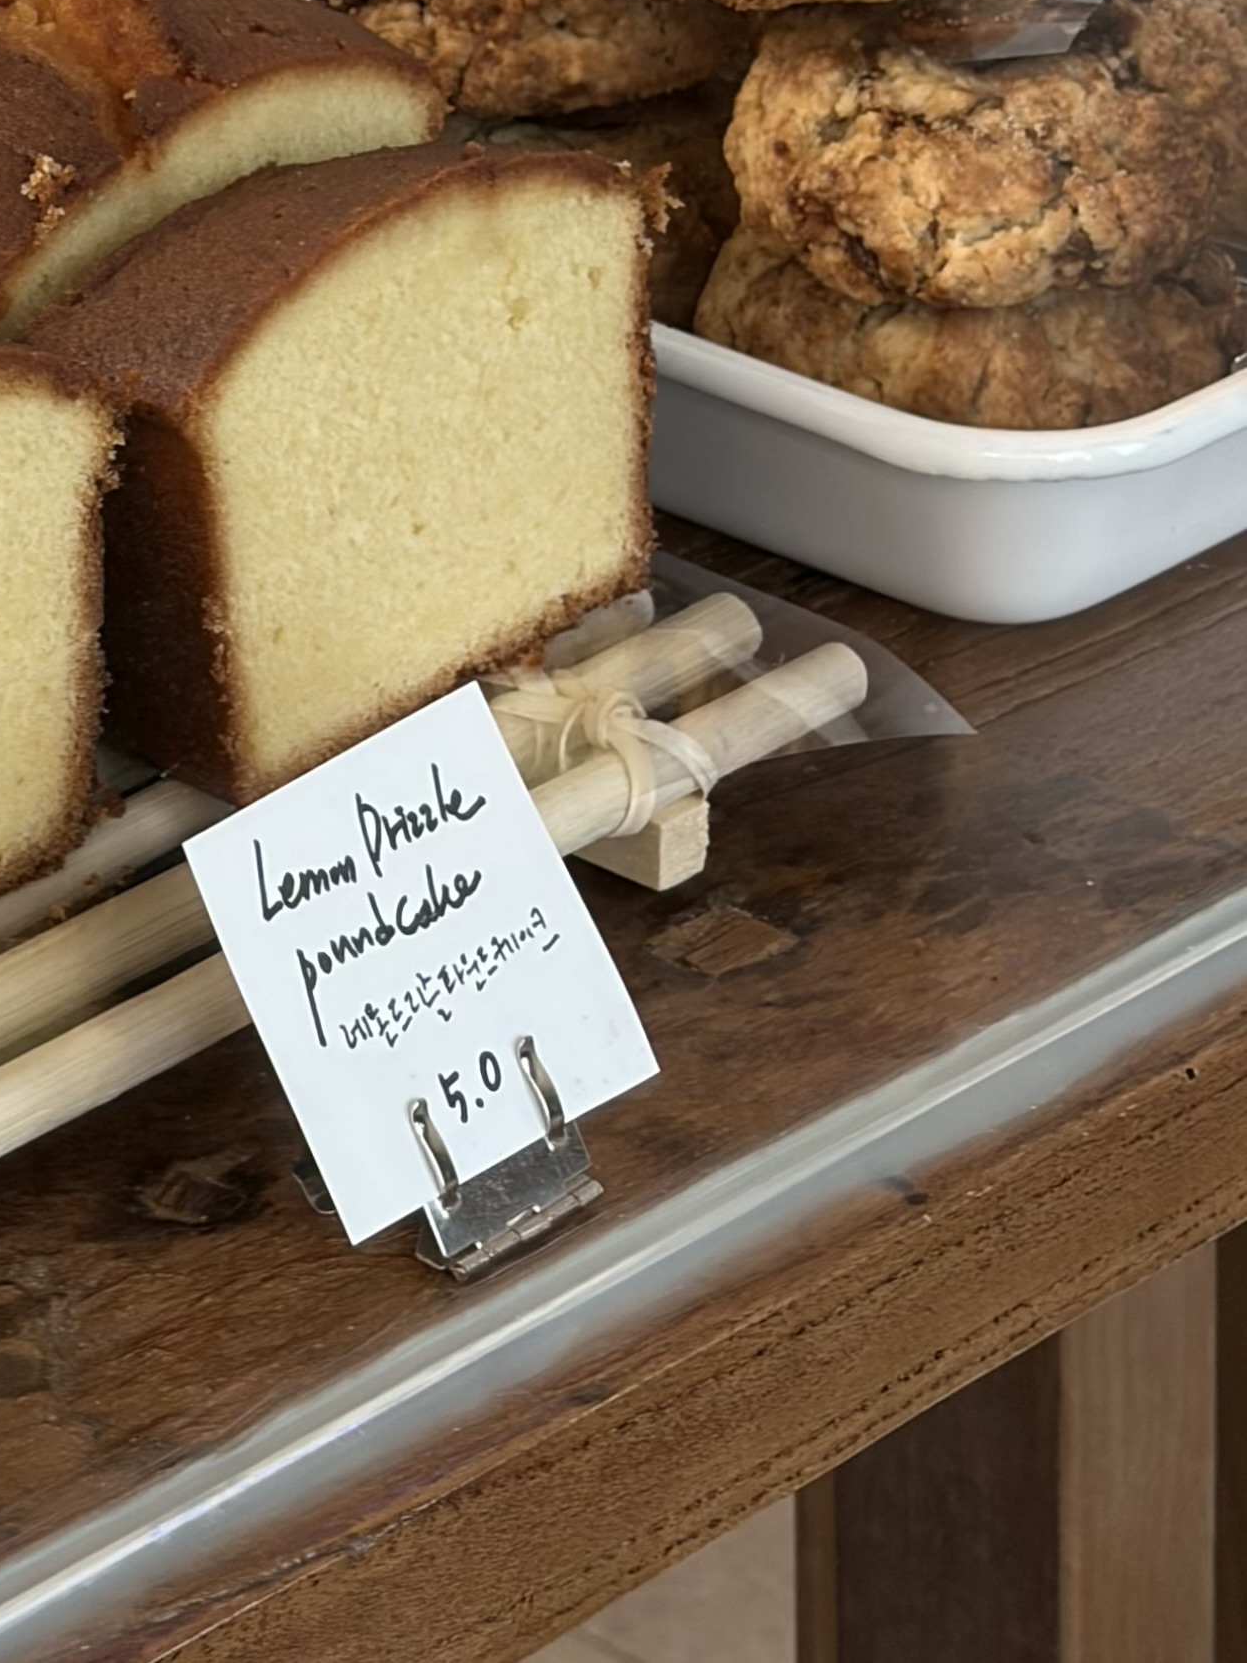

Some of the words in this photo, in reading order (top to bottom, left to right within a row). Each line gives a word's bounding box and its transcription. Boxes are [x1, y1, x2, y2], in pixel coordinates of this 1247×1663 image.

[253, 839, 358, 921] Lemon
[355, 763, 487, 878] Drizzle
[438, 1050, 503, 1124] 5.0
